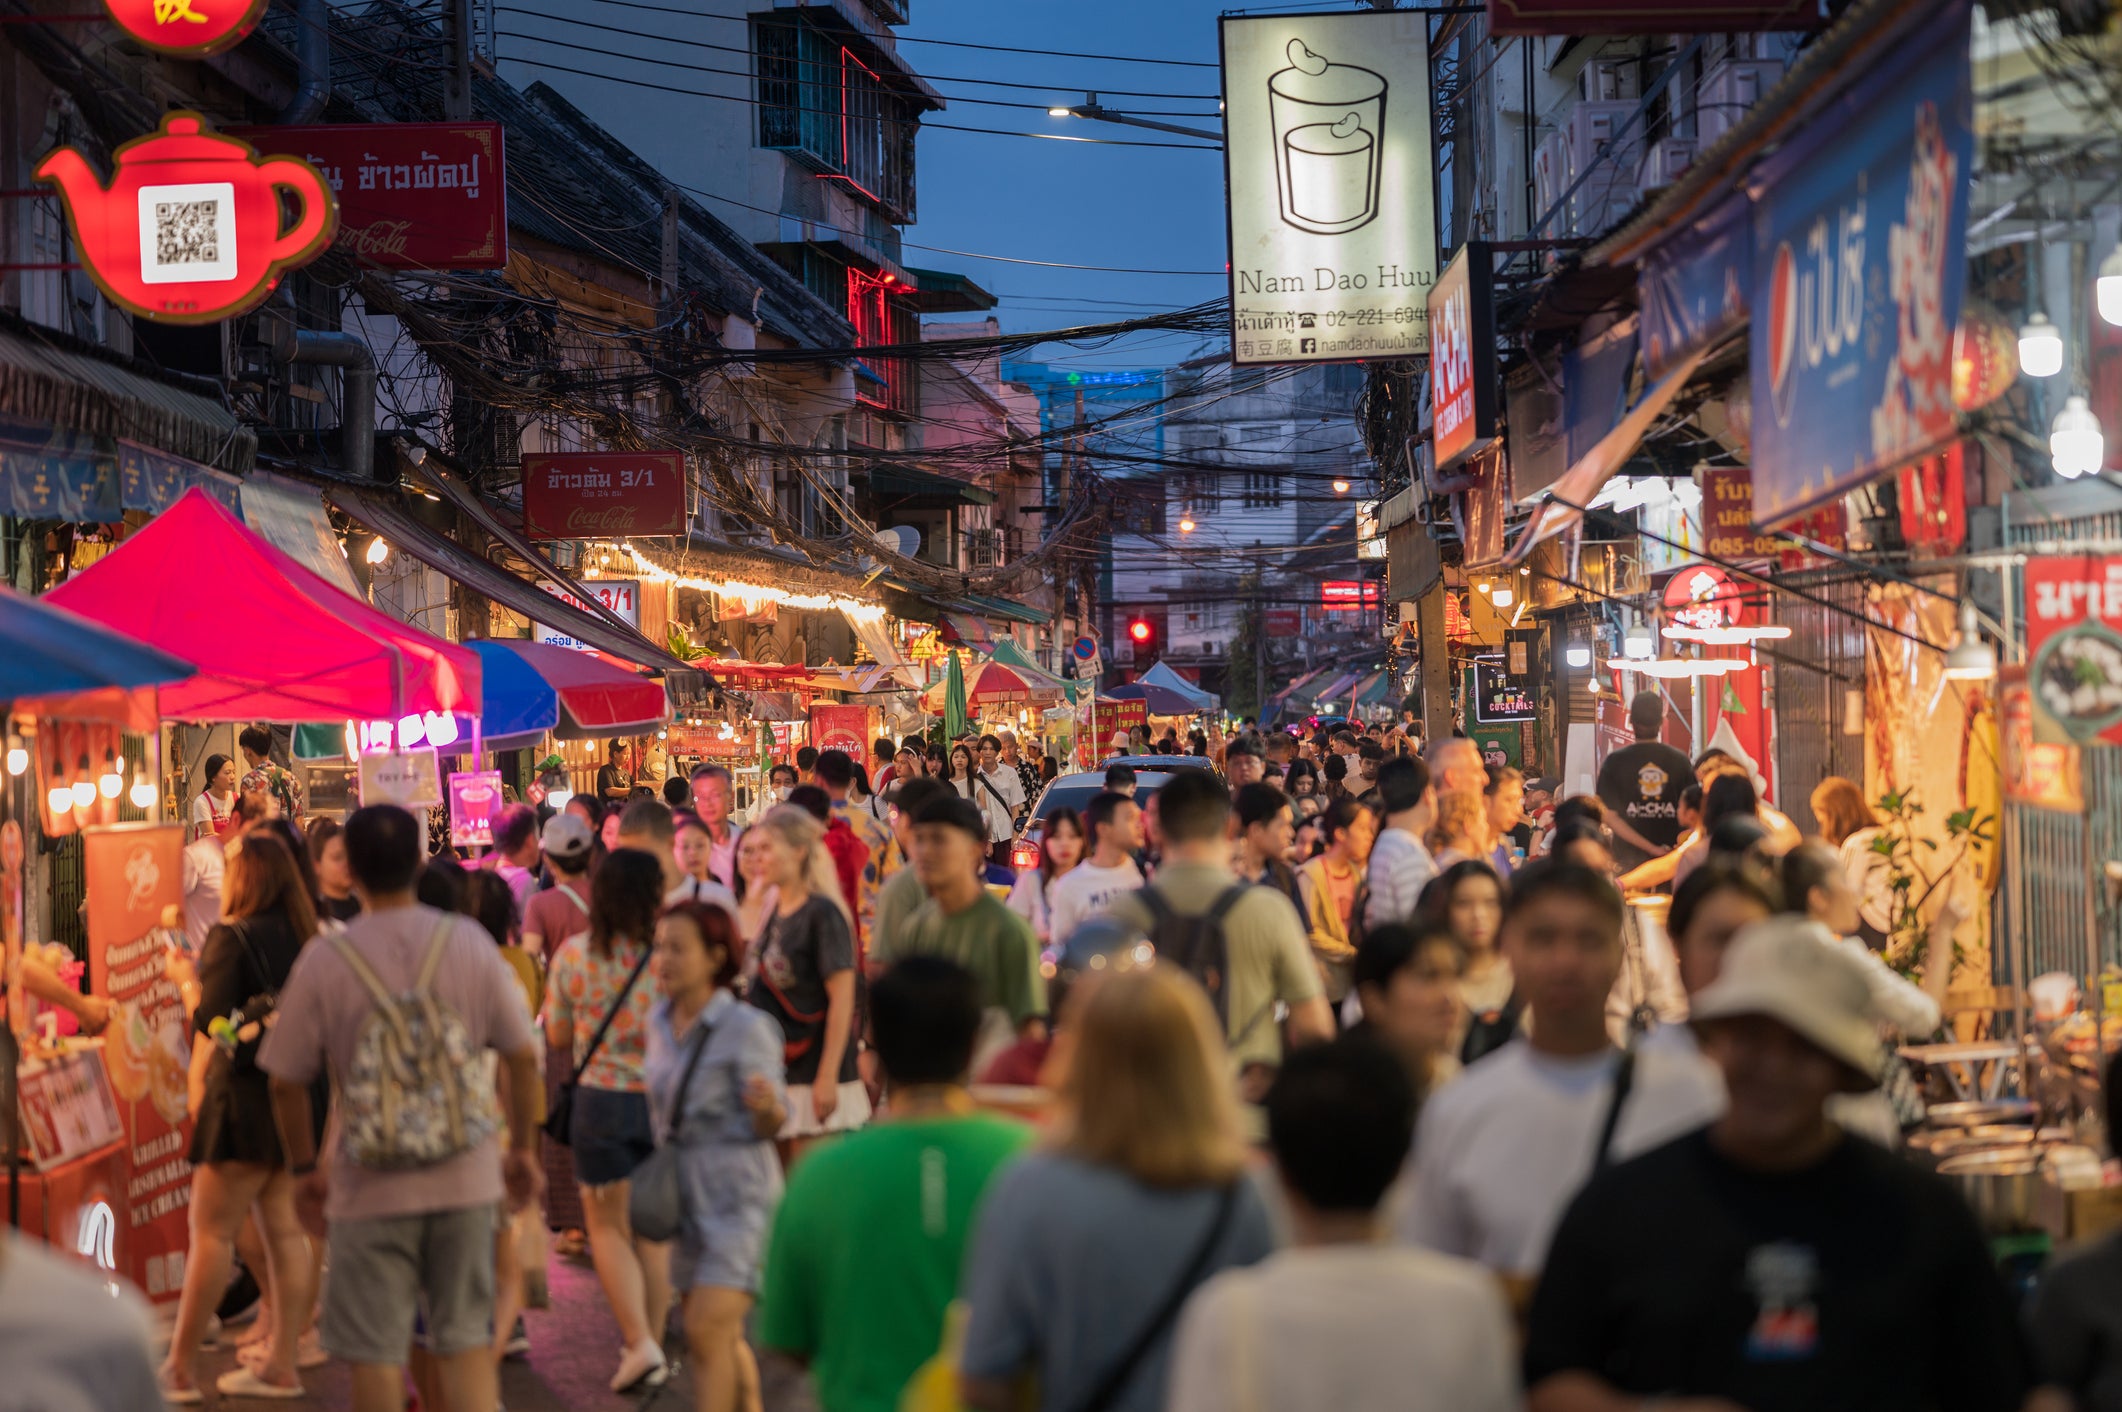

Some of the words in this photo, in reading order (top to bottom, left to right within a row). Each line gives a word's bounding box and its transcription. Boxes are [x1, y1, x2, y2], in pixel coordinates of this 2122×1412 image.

[358, 151, 480, 199] ข้าวผัดปู
[1239, 269, 1304, 294] Nam
[1314, 267, 1368, 291] Dao
[1377, 264, 1432, 288] Huu
[1237, 339, 1293, 357] 南豆腐
[548, 466, 611, 489] ข้าวต้ม
[620, 468, 655, 487] 3/1
[566, 505, 639, 530] Coca-Cola
[1489, 701, 1534, 712] COCKTAILS
